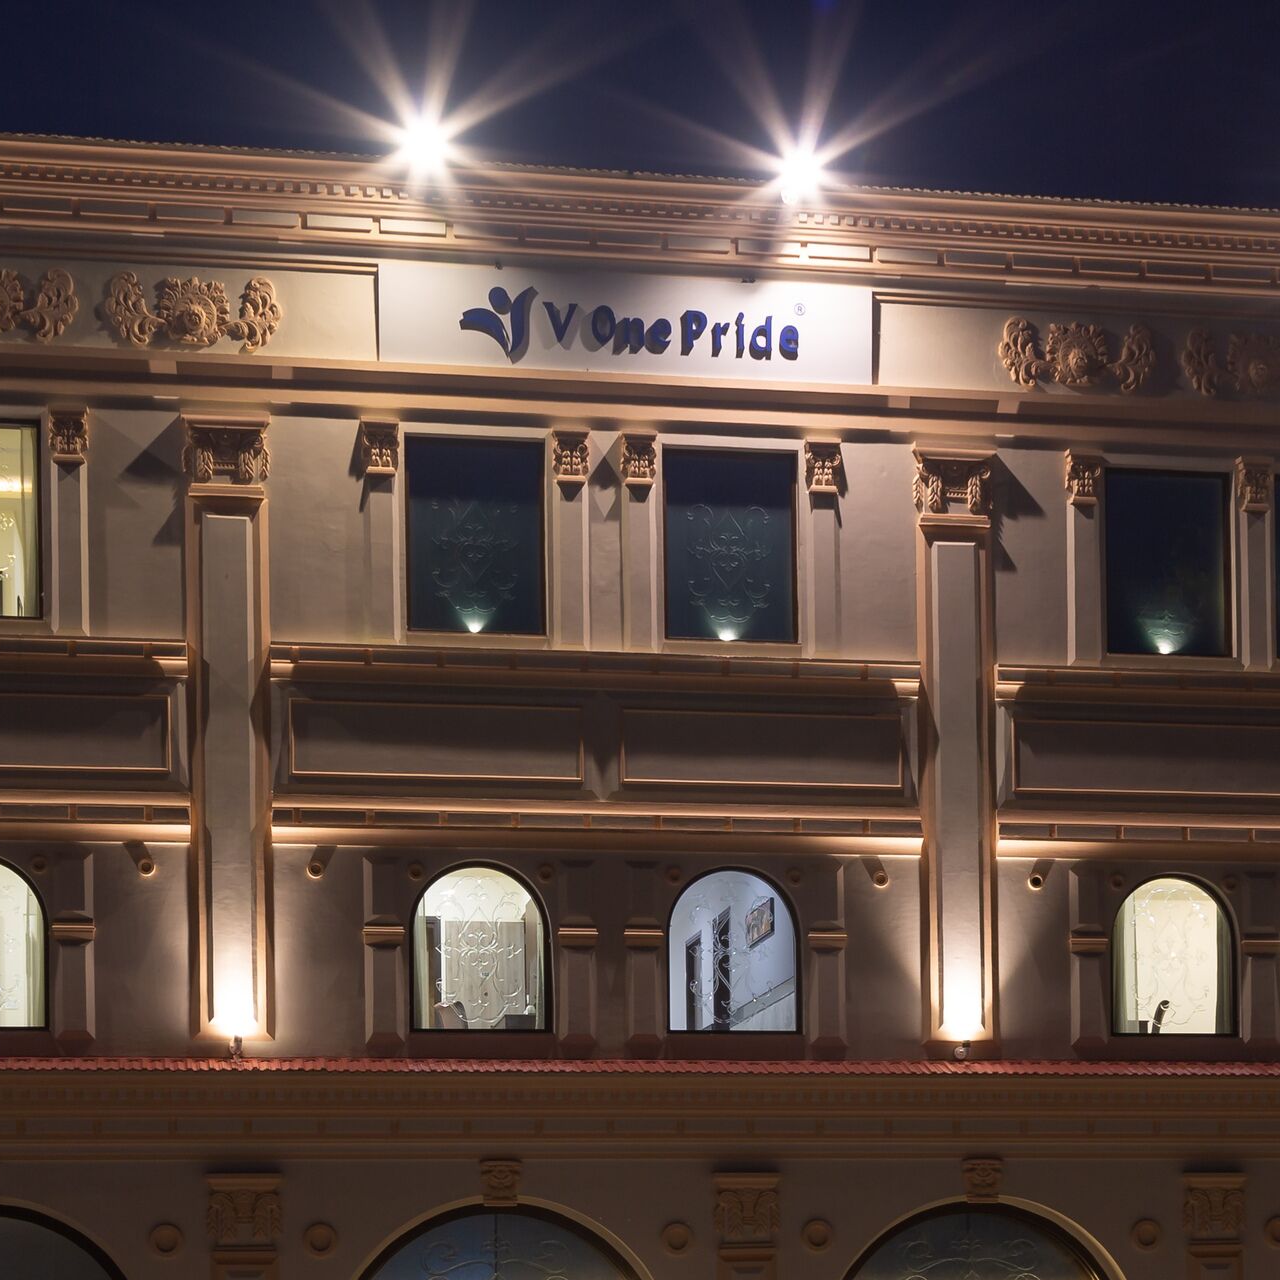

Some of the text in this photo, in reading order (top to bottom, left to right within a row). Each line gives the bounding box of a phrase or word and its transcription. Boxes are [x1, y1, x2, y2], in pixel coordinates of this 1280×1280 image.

[543, 302, 578, 343] V
[591, 305, 671, 354] One
[680, 310, 799, 360] Pride
